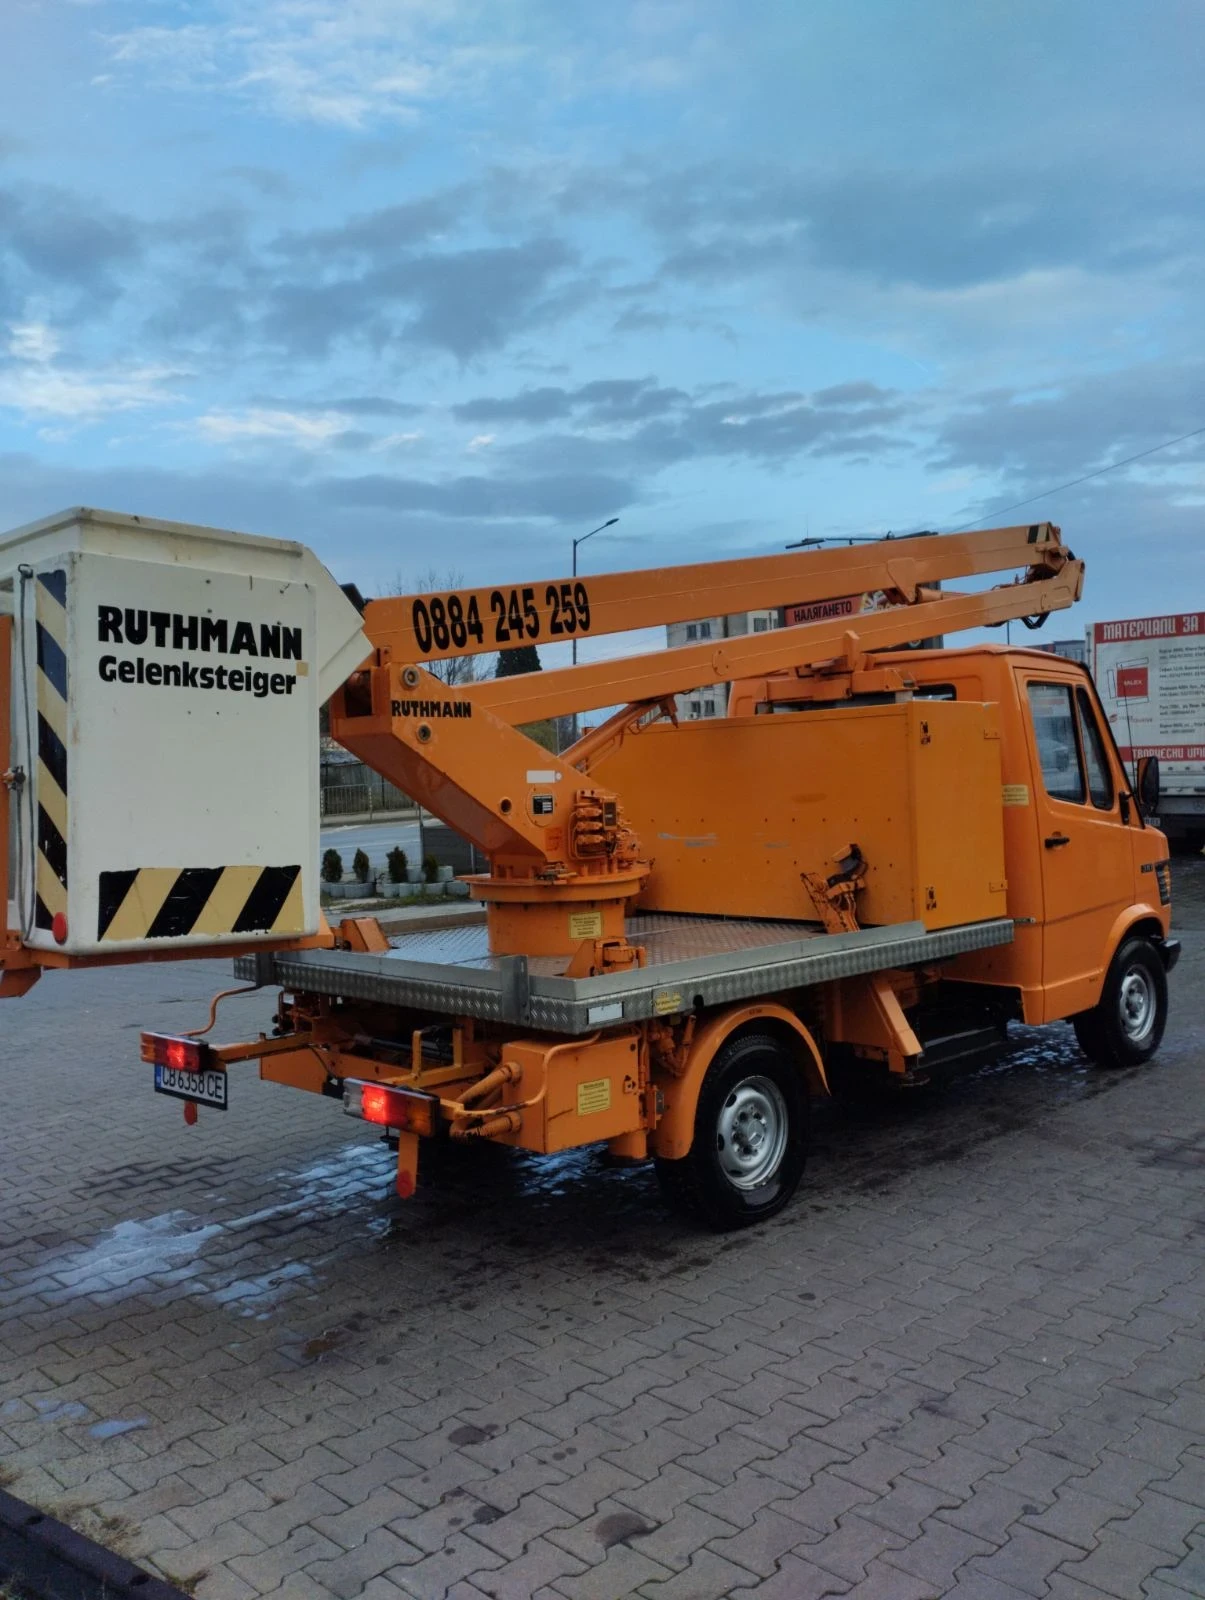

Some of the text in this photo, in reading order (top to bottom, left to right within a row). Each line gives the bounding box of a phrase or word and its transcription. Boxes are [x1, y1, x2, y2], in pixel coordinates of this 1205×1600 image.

[98, 605, 302, 660] RUTHMANN
[412, 582, 591, 653] 0884 245 259
[794, 601, 853, 623] НАЛЯГАНЕТО
[98, 655, 297, 698] Gelenksteiger
[391, 699, 472, 718] RUTHMANN
